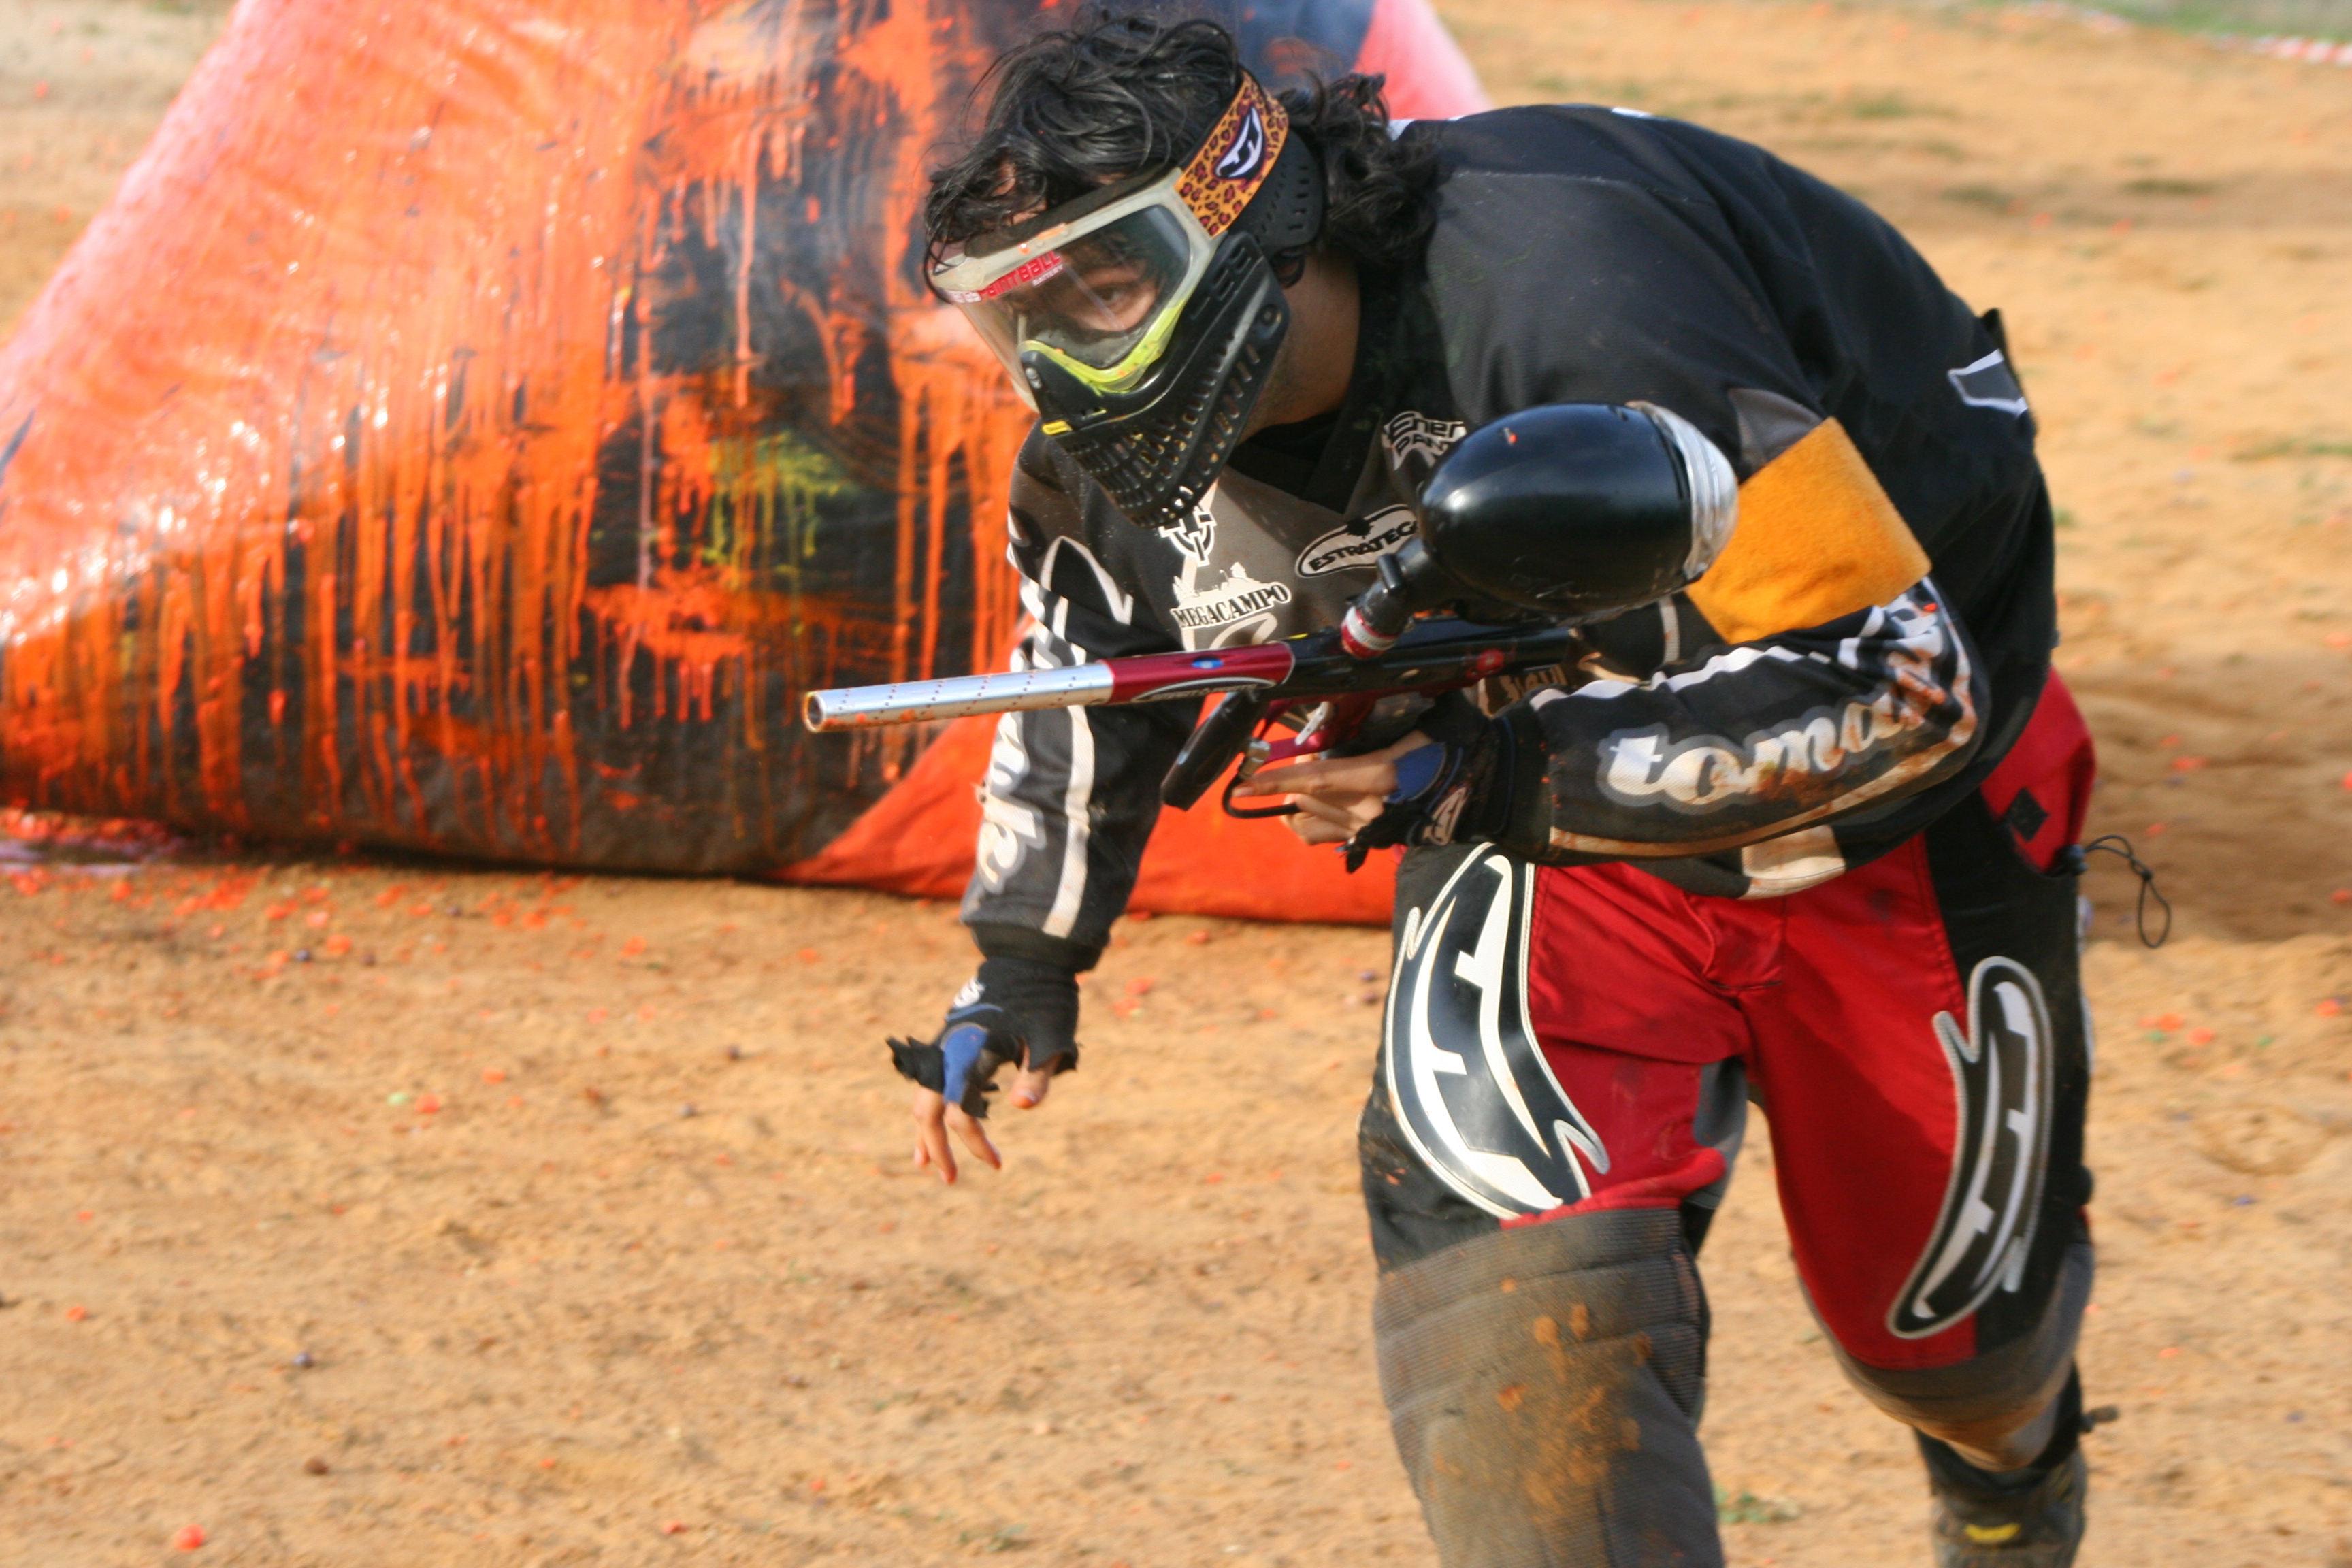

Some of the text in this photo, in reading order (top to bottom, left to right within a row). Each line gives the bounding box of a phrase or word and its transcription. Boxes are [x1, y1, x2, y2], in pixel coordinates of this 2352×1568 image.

[1388, 412, 1465, 443] Ener
[1308, 520, 1418, 572] ESTRATEG
[1173, 584, 1288, 627] MEGACAMPO
